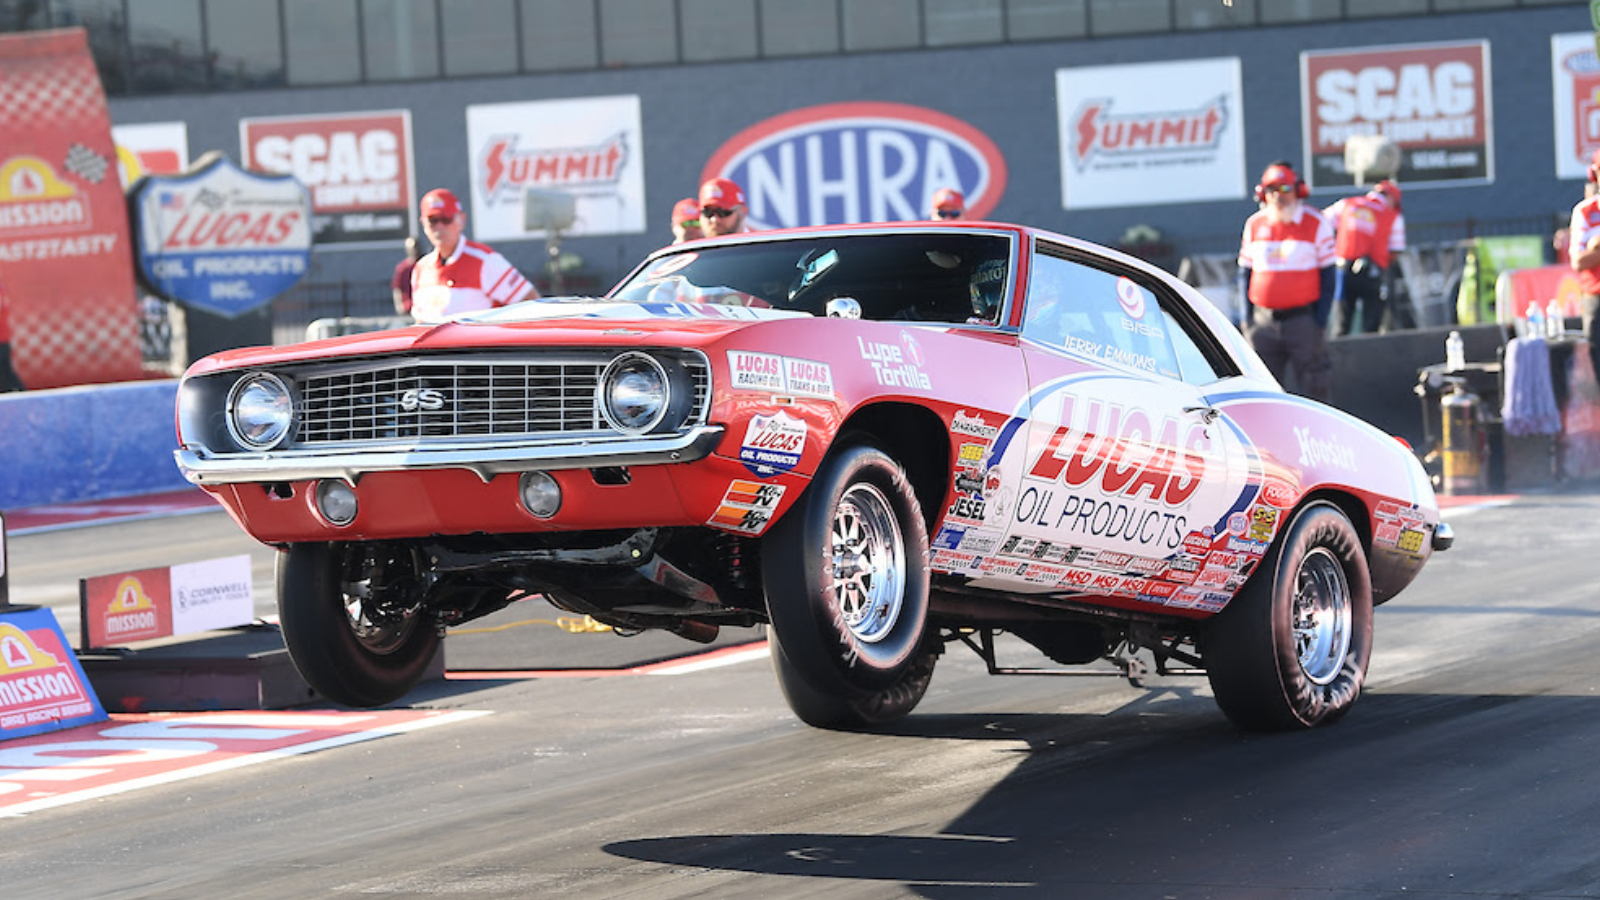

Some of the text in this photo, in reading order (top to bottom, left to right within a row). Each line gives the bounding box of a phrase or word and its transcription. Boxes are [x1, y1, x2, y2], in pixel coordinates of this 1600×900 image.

[1317, 60, 1475, 122] SCAG
[255, 130, 399, 188] SCAG
[747, 124, 956, 228] NHRA
[164, 211, 299, 250] LUCAS
[0, 233, 117, 262] AST2TASTY
[153, 255, 304, 278] OIL PRODUCTS
[858, 335, 901, 363] Lupe
[1063, 334, 1157, 372] JERRY EMMONS
[736, 354, 779, 373] LUCAS
[790, 361, 828, 383] LUCAS
[737, 373, 781, 388] RACING OIL
[789, 380, 810, 393] TRANS
[871, 361, 932, 390] Tortilla
[749, 430, 802, 451] LUCAS
[1028, 392, 1214, 506] LUCAS
[740, 449, 799, 465] OIL PRODUCTS
[949, 498, 986, 520] JESEL
[1016, 486, 1053, 527] OIL
[1055, 495, 1187, 549] PRODUCTS
[1062, 568, 1092, 585] MSD
[1091, 573, 1119, 588] MSD
[1119, 578, 1145, 592] MSD
[191, 582, 248, 599] CORNWELL
[107, 612, 155, 634] MISSION
[1, 709, 24, 726] DRAG
[56, 699, 91, 717] SERIES
